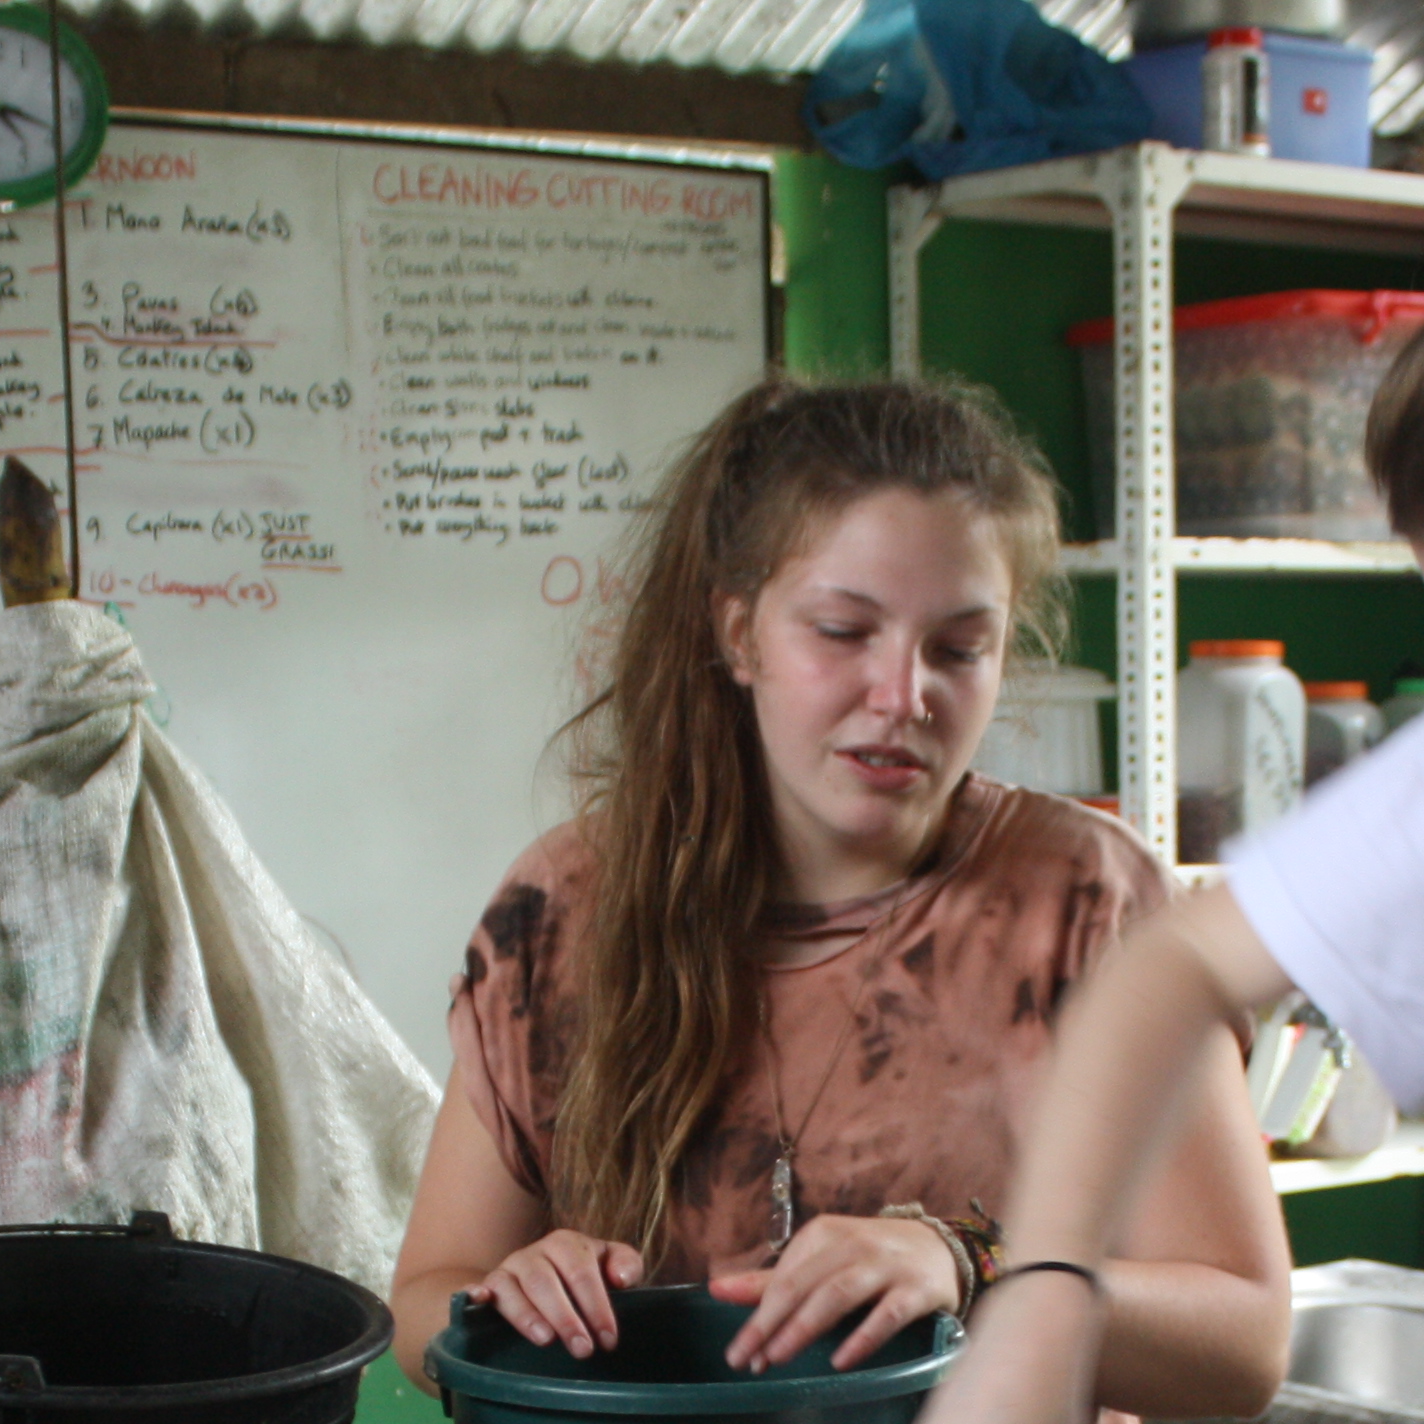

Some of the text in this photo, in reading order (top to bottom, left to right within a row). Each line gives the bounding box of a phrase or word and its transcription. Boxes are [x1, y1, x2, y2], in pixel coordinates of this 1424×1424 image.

[371, 162, 540, 210] CLEANING
[545, 170, 672, 216] CUTTING
[106, 201, 161, 231] Mono
[112, 414, 192, 450] Mapache
[200, 407, 257, 453] (x1)
[258, 510, 312, 538] JUST
